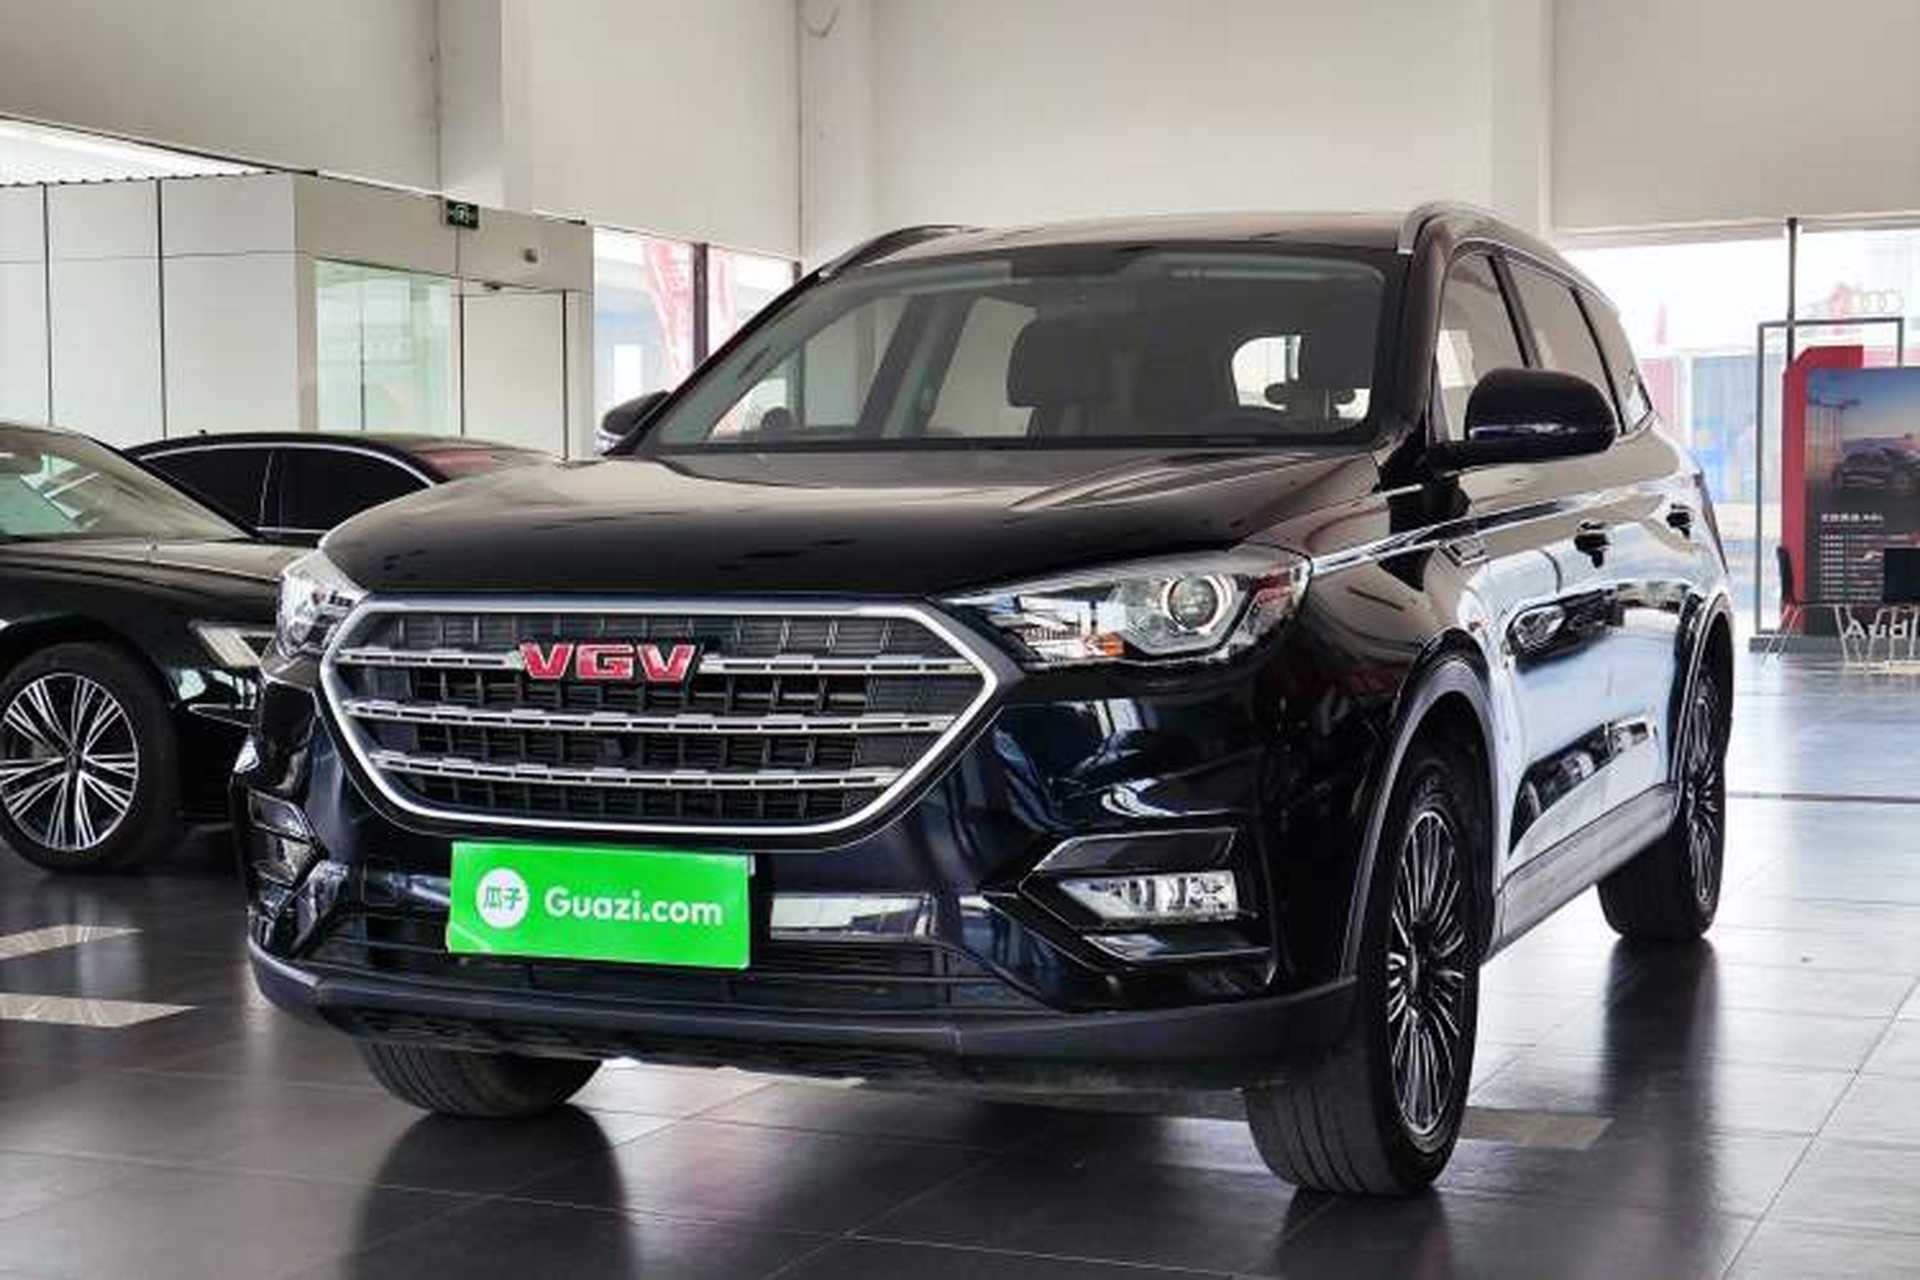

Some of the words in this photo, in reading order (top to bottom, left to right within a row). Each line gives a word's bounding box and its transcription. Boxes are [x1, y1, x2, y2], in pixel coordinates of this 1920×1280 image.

[1843, 619, 1917, 639] Aud
[519, 643, 696, 681] VGV
[483, 885, 522, 911] 瓜子
[546, 886, 722, 925] Guazi.com
